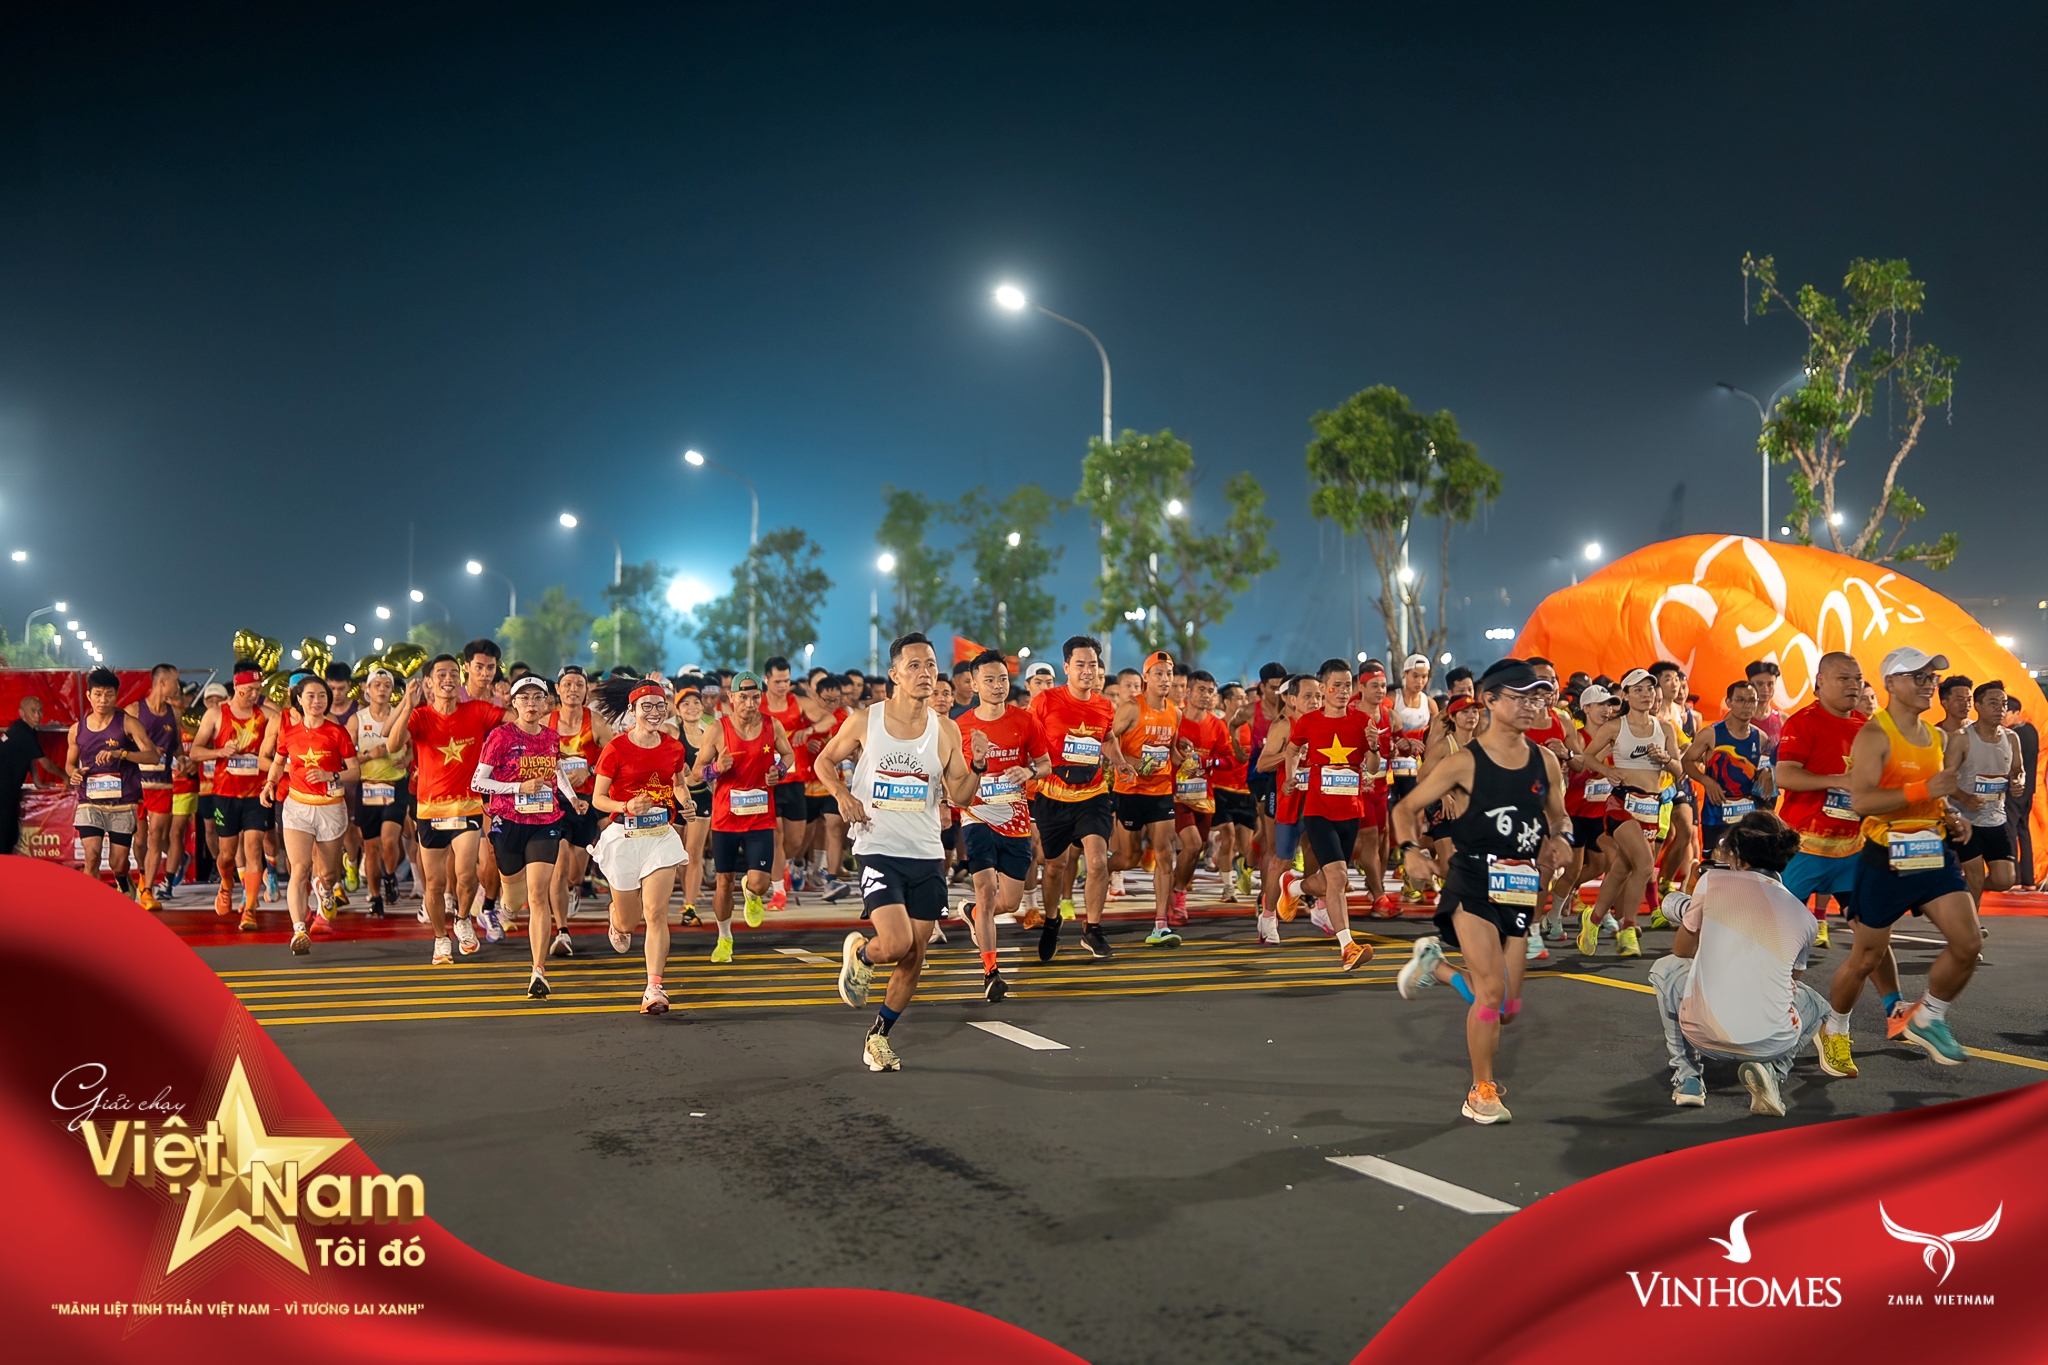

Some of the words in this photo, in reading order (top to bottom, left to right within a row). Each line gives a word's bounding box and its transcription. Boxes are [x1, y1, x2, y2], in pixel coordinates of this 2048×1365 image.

[1064, 743, 1074, 753] M
[1076, 743, 1099, 751] D37232
[1634, 745, 1646, 753] NIK
[228, 759, 236, 767] M
[879, 754, 923, 774] CHICAGO
[1322, 777, 1332, 786] M
[363, 789, 371, 797] M
[875, 785, 888, 798] M
[893, 785, 924, 795] D63174
[982, 785, 993, 796] M
[1976, 784, 1986, 792] M
[518, 794, 524, 803] F
[1826, 795, 1839, 806] M
[1723, 807, 1733, 816] M
[628, 818, 634, 828] F
[1891, 844, 1905, 857] M
[1491, 875, 1505, 890] M
